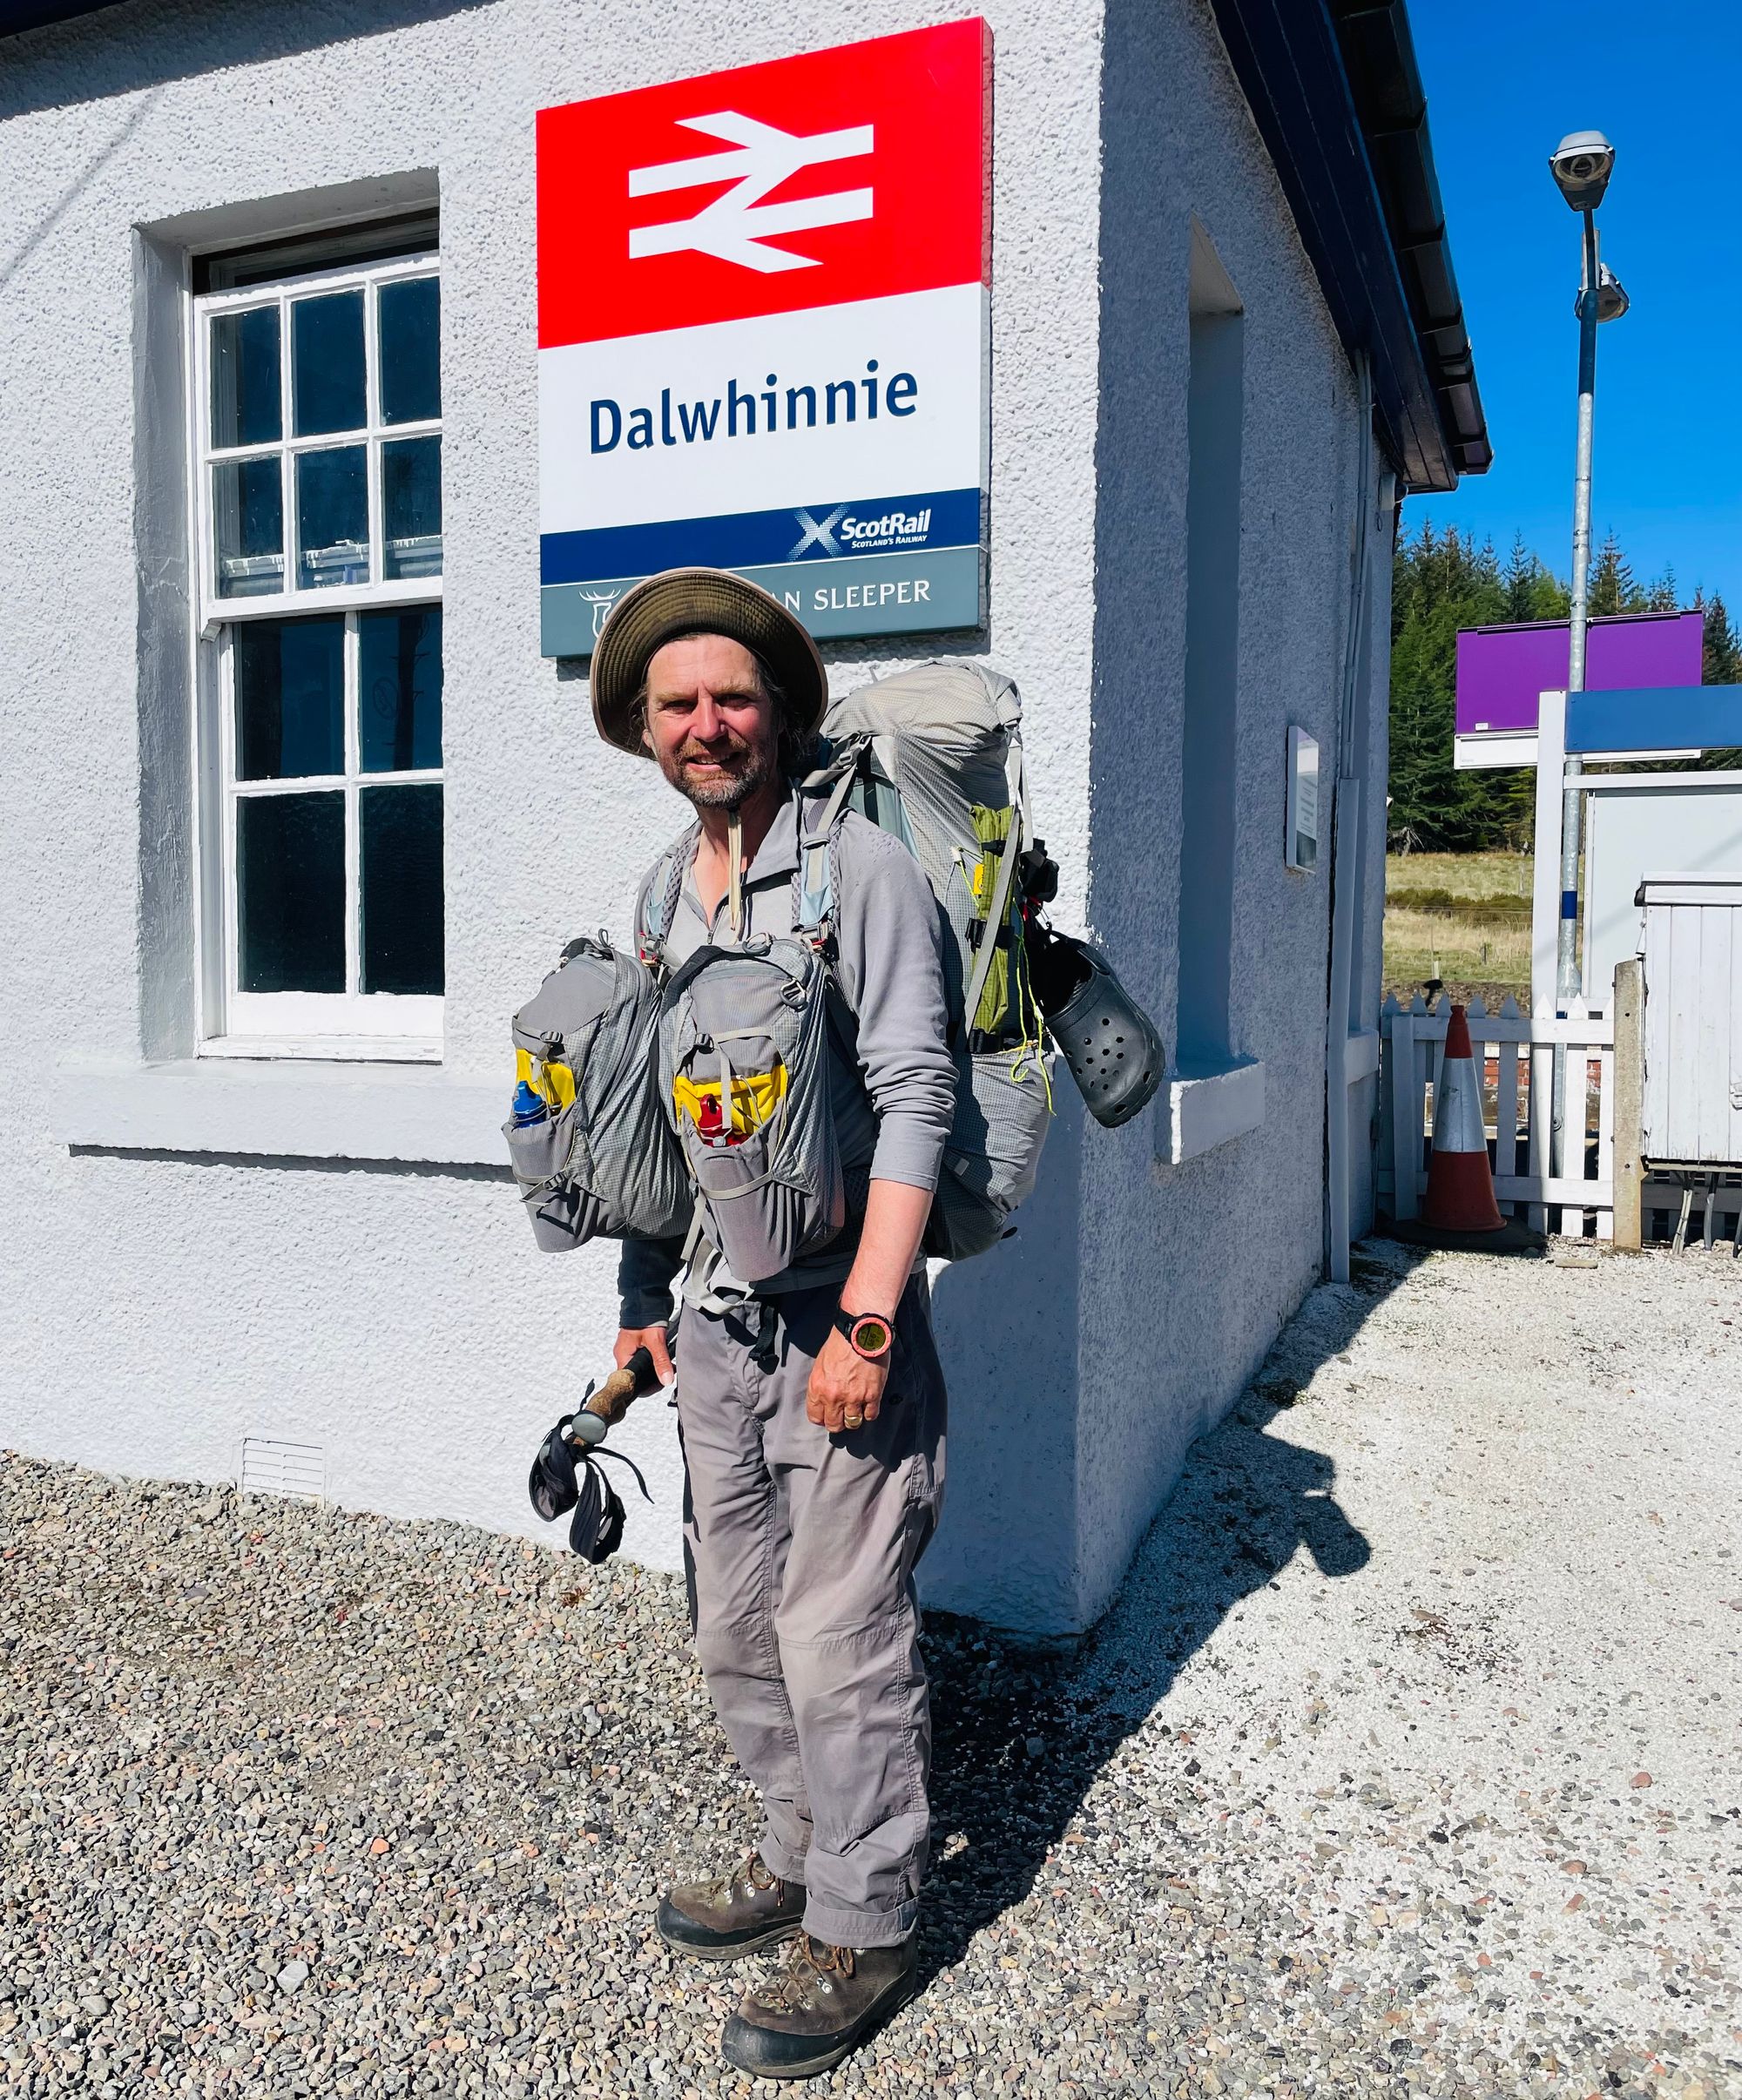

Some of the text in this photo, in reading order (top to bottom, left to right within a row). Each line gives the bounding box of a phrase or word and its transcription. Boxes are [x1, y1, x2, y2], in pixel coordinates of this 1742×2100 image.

[590, 359, 918, 455] Dalwhinnie
[841, 509, 931, 540] ScotRail
[851, 535, 928, 549] SCOTLAND'S RAILWAY
[814, 580, 931, 611] SLEEPER
